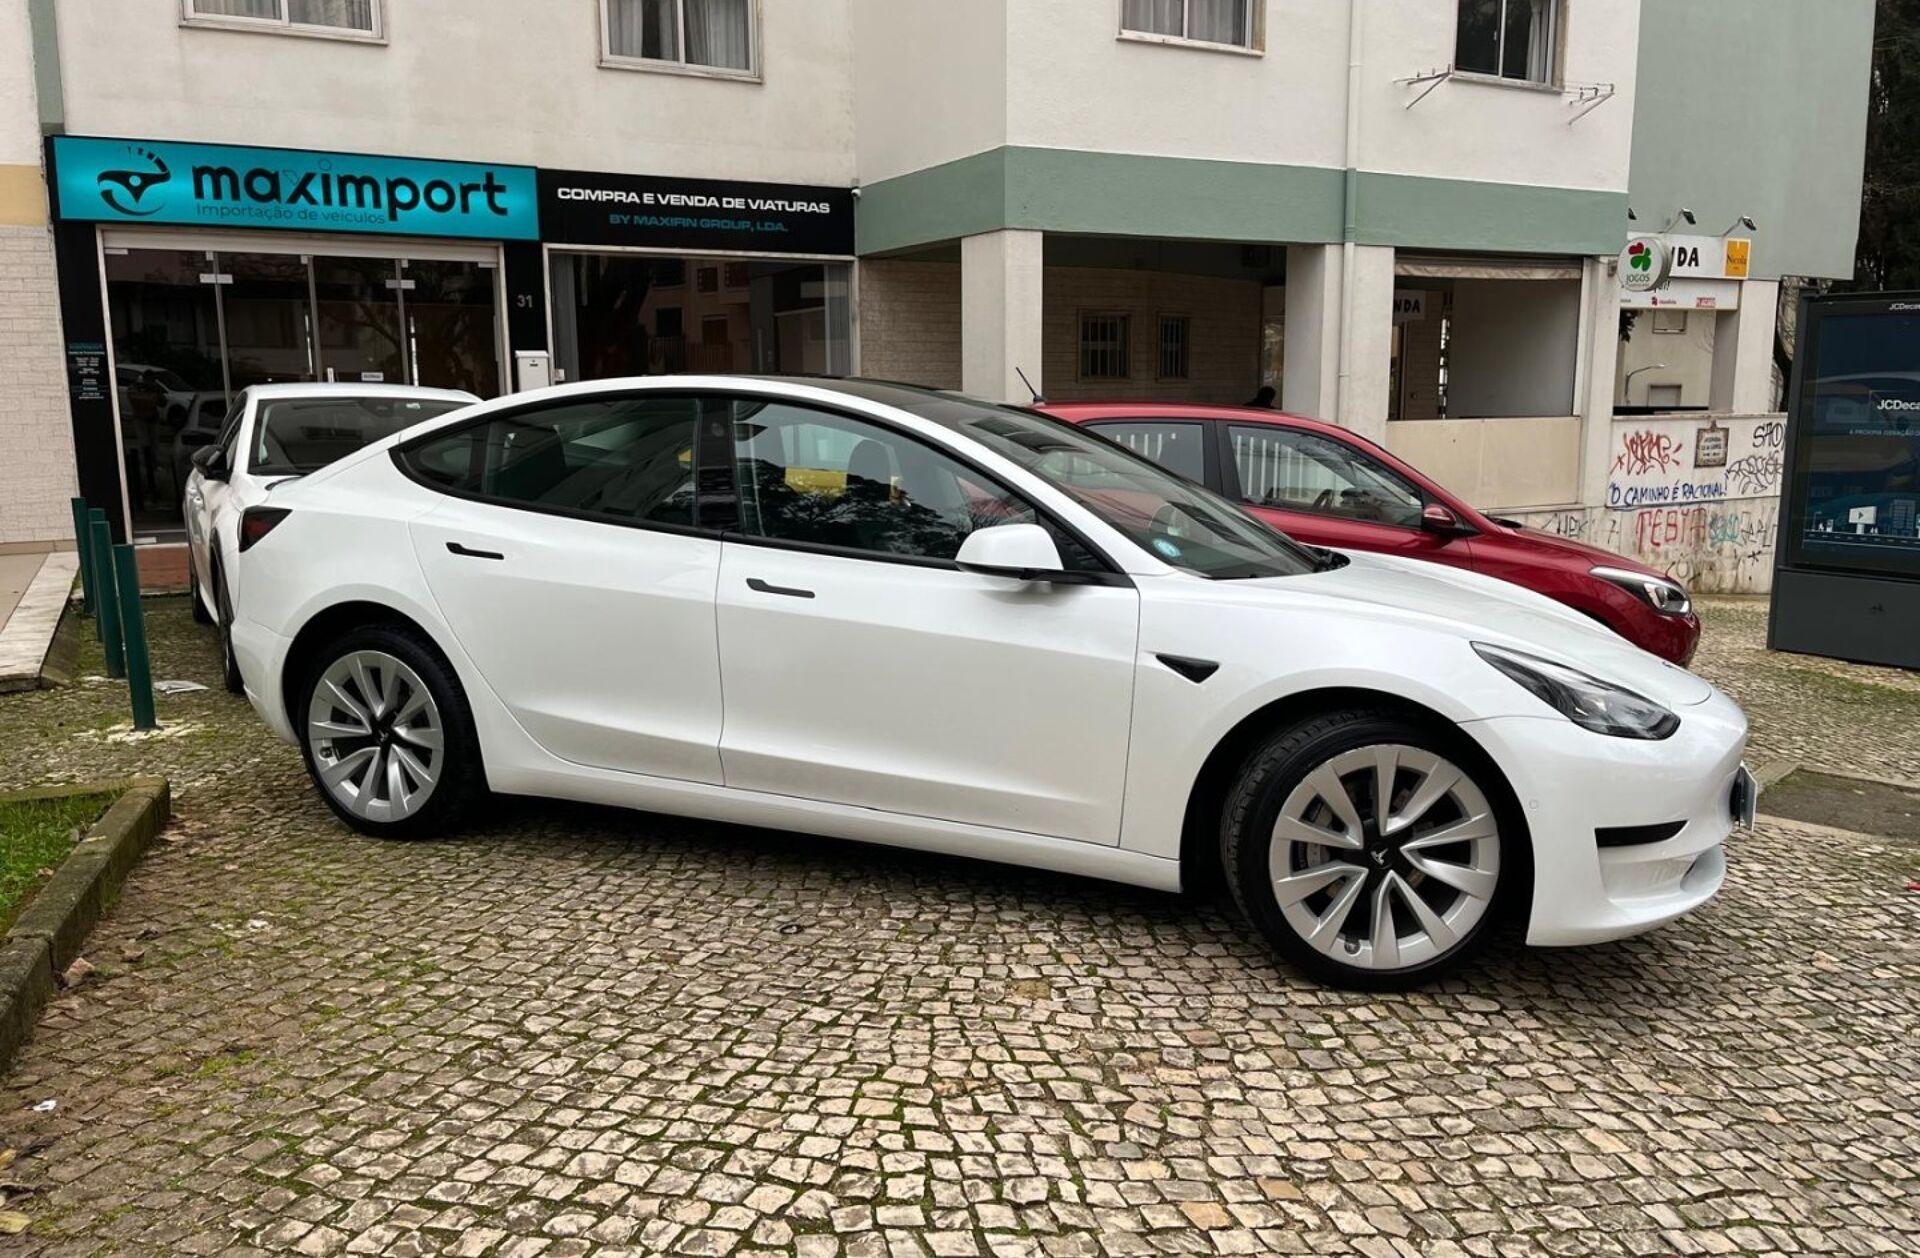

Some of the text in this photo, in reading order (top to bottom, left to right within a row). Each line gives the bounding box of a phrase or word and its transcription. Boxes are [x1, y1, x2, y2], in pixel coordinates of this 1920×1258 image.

[191, 158, 508, 222] maximport
[557, 187, 831, 215] COMPRA E VENDA DE VIATURAS
[196, 203, 293, 221] Importação
[297, 207, 319, 221] de
[608, 213, 631, 225] BY
[516, 294, 533, 308] 31
[1624, 486, 1670, 508] CAMINHO
[1671, 479, 1680, 501] É
